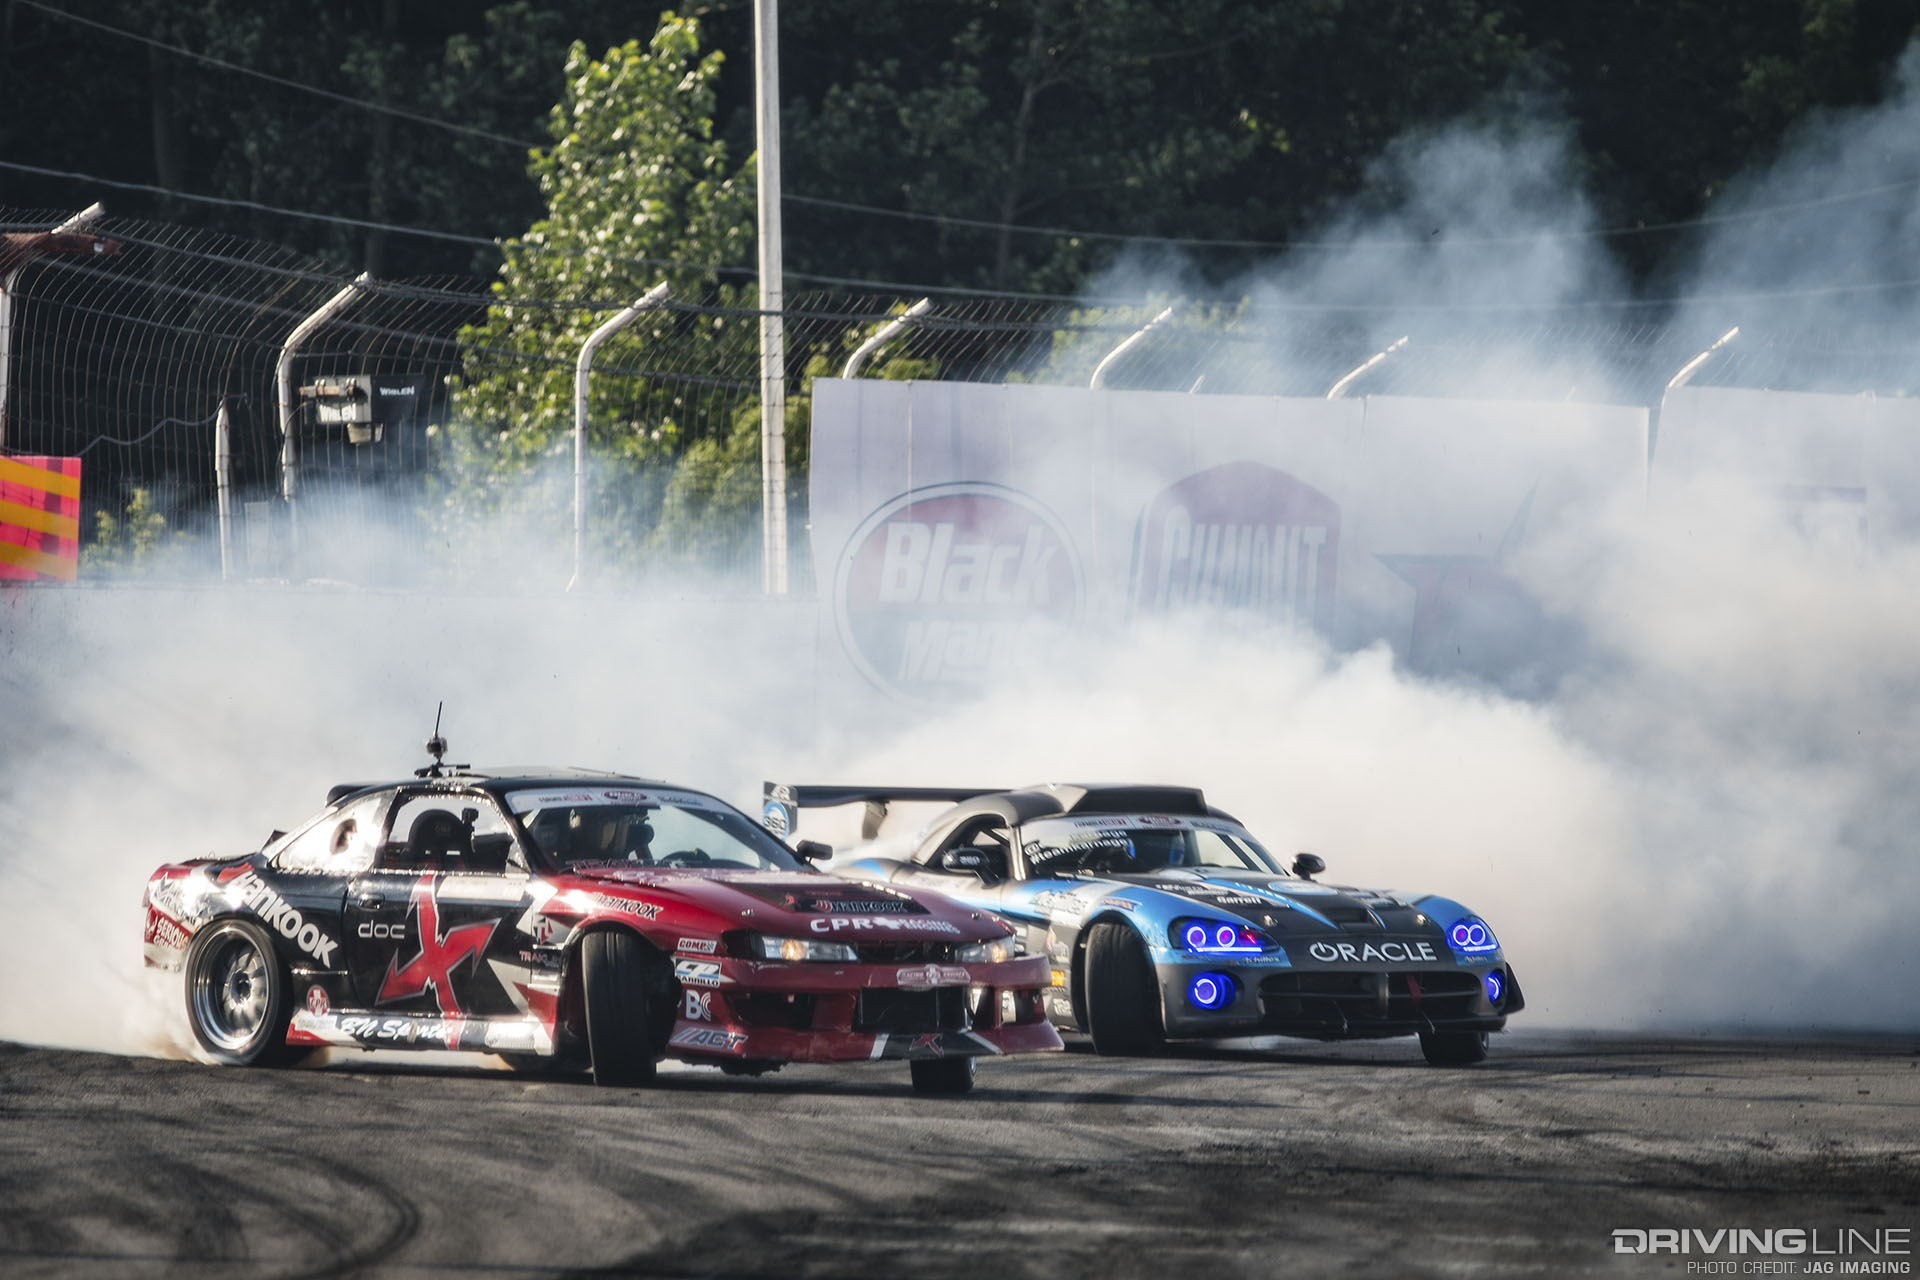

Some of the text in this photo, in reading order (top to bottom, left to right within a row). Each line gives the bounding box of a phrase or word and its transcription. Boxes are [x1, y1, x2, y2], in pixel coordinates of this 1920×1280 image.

[879, 521, 1057, 601] Black
[358, 919, 406, 939] doc
[810, 918, 873, 933] CPR
[1309, 942, 1437, 961] ORACLE
